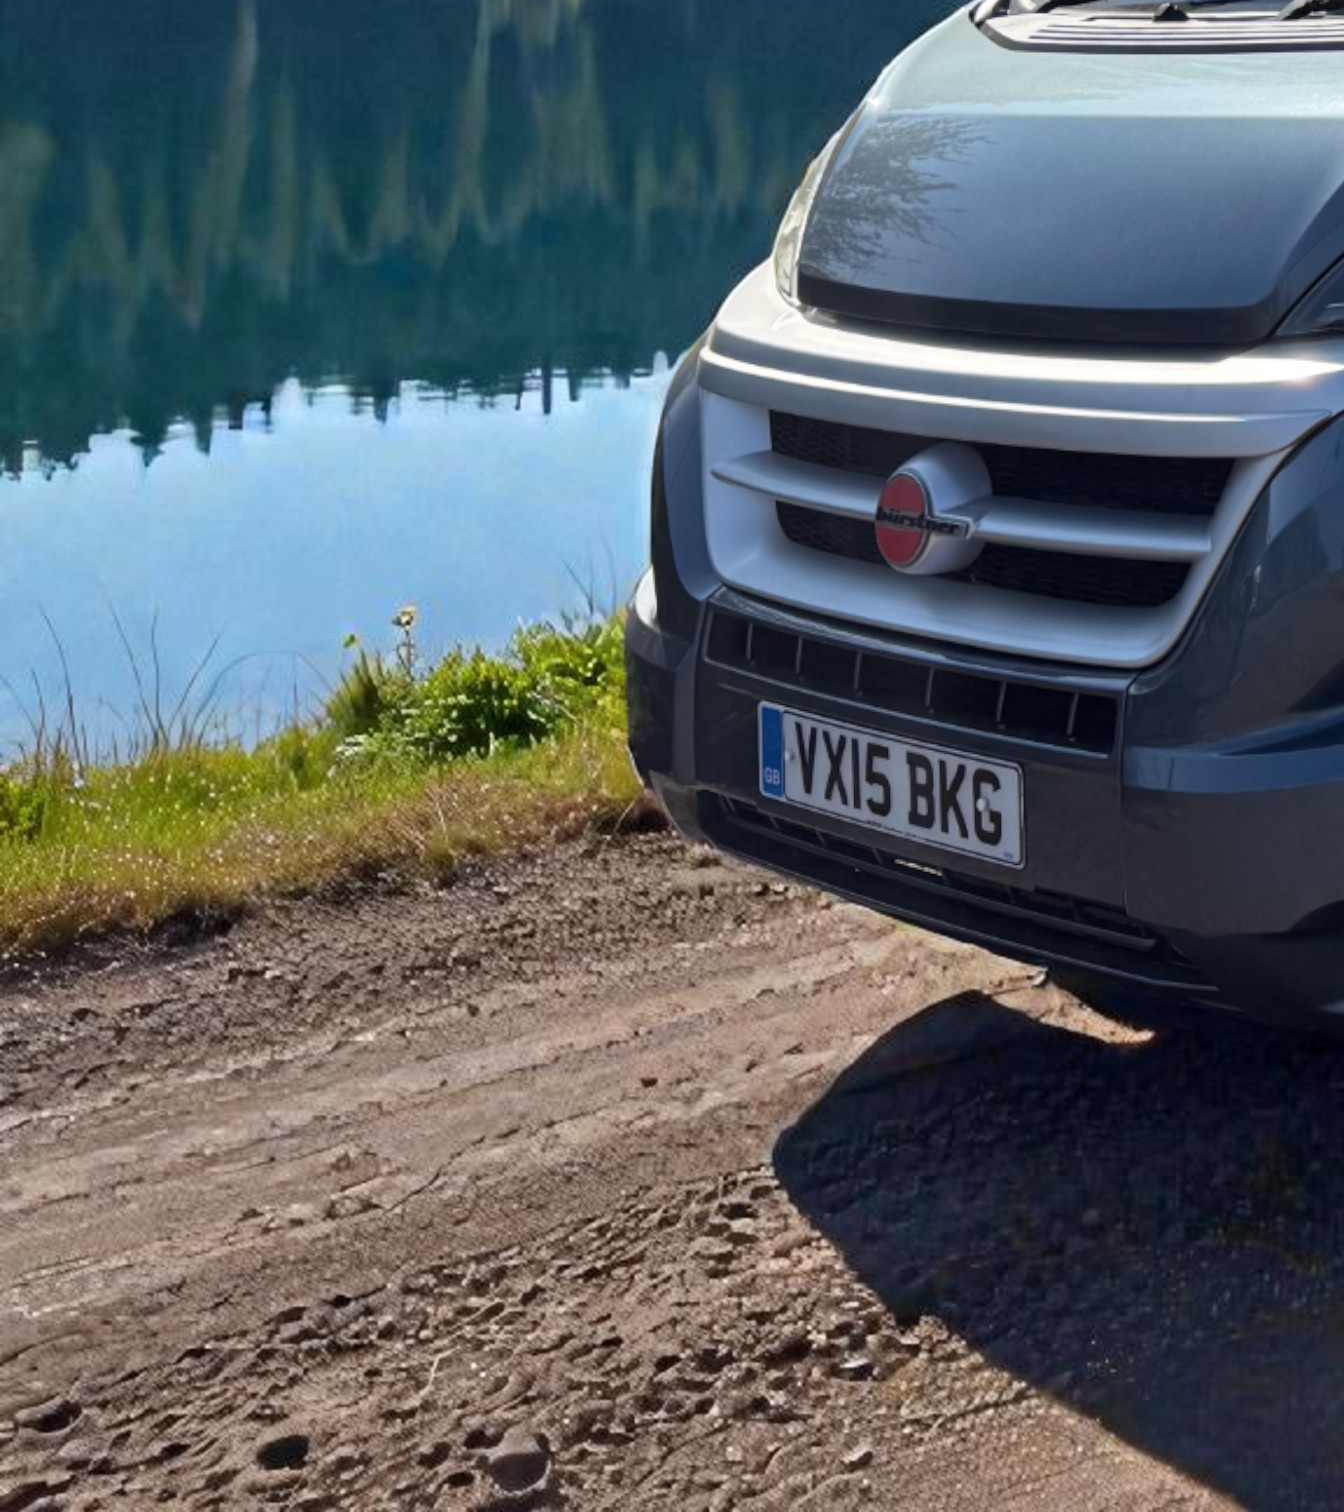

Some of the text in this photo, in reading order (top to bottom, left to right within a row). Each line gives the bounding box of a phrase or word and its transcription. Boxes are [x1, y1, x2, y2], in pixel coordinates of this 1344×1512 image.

[763, 766, 781, 785] GB
[794, 721, 1002, 846] VX15 BKG
